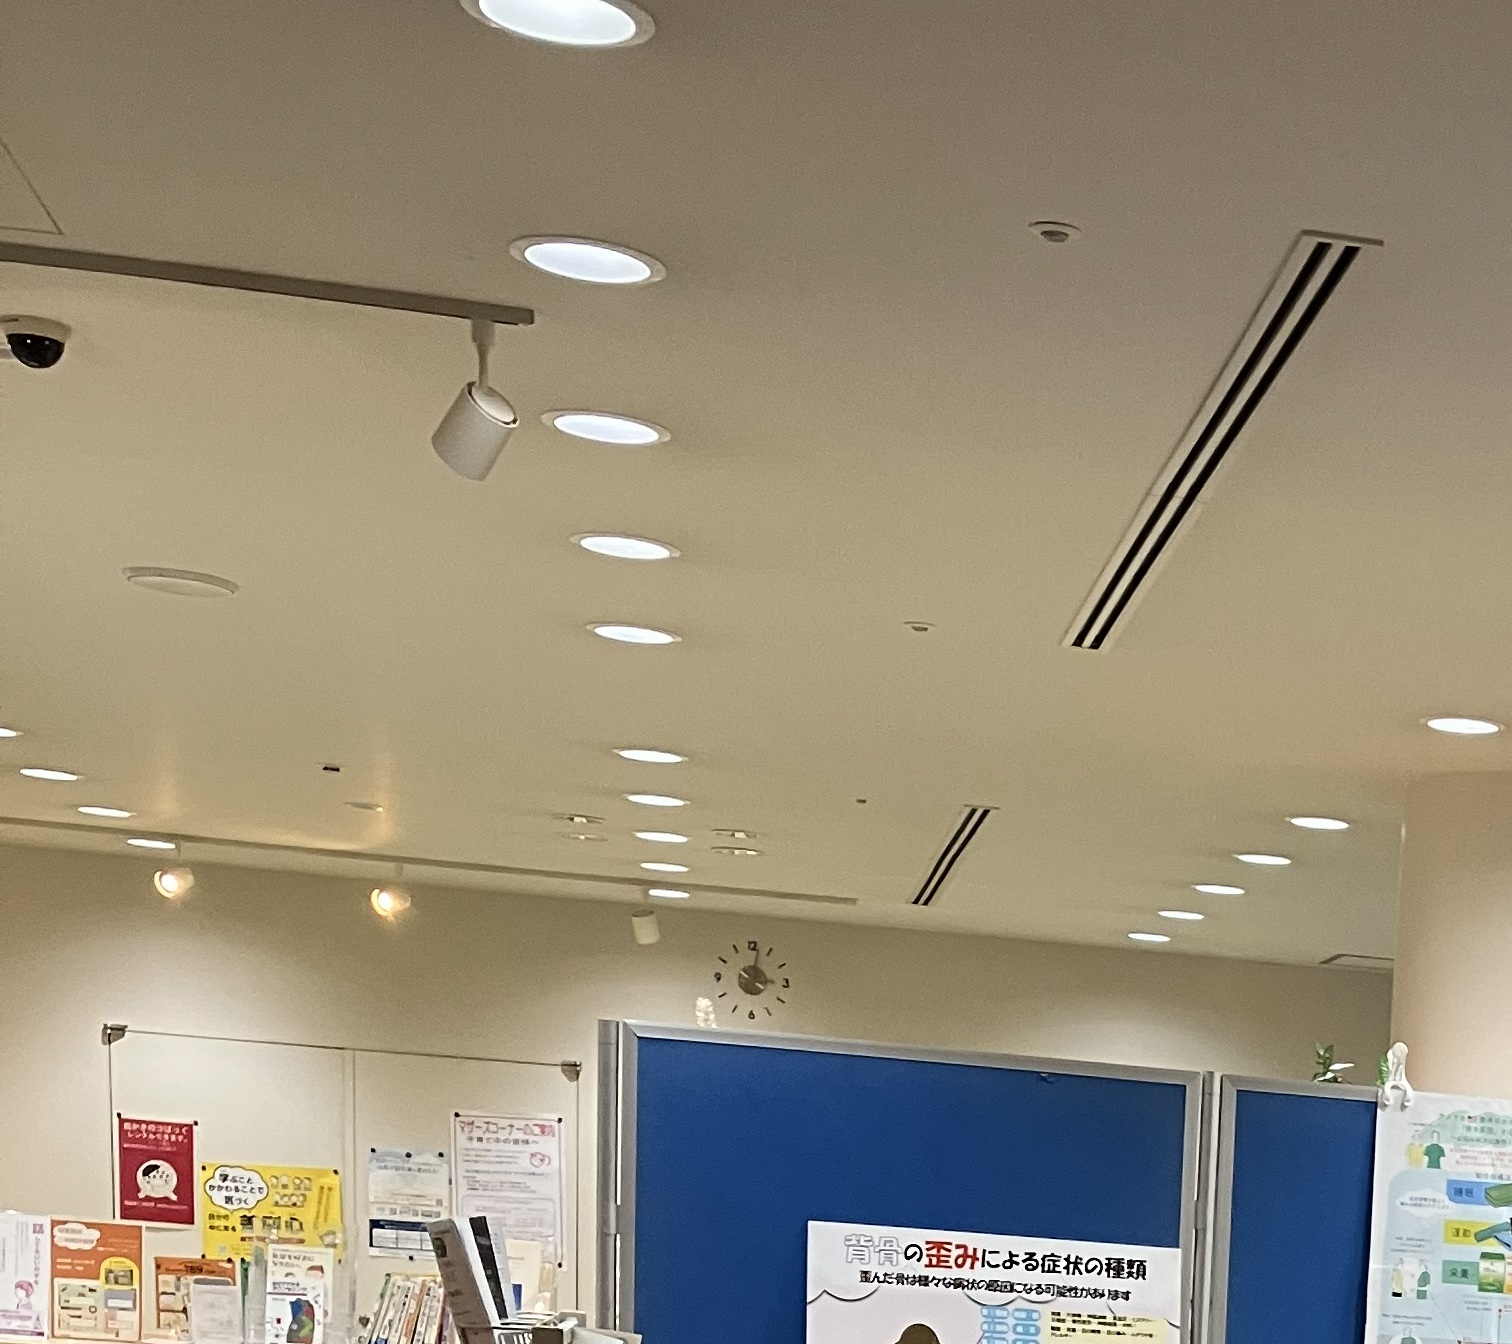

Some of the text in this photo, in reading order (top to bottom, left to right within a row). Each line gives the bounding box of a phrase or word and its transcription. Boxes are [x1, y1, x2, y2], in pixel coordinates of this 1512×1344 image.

[748, 1010, 755, 1020] 6
[844, 1233, 1148, 1280] 背骨の歪みによる症状の種類
